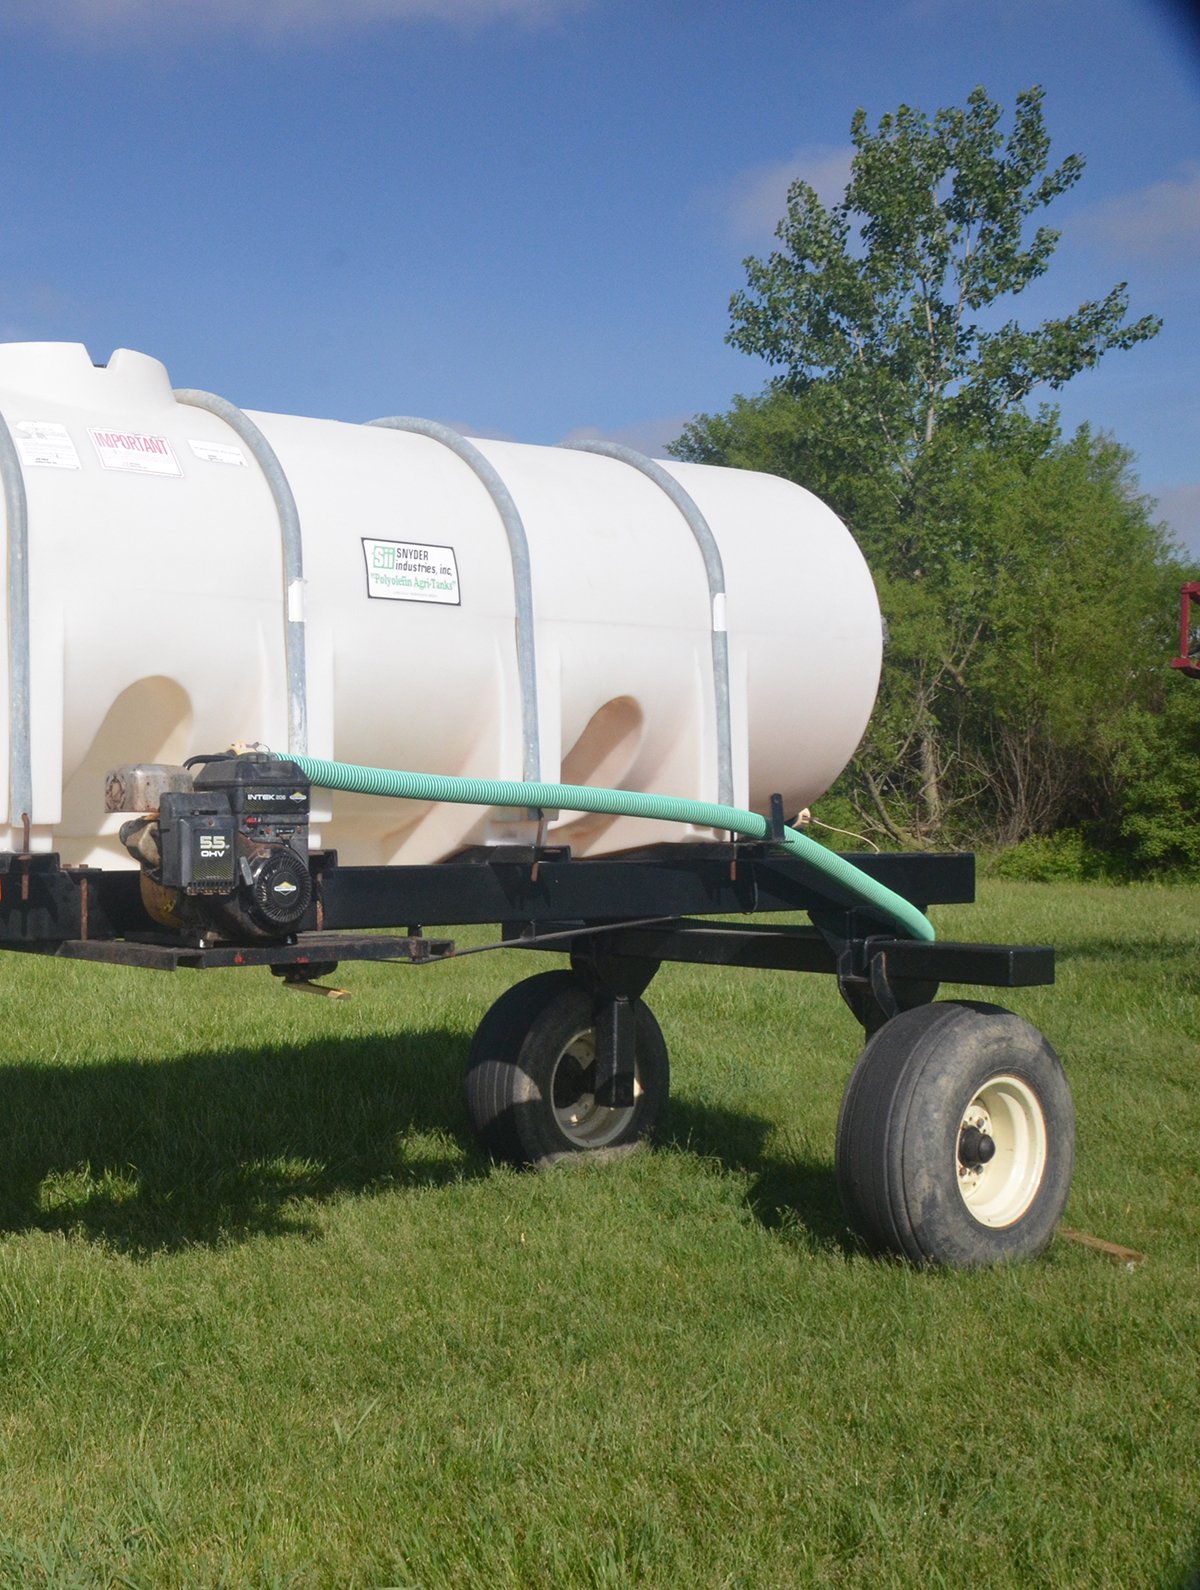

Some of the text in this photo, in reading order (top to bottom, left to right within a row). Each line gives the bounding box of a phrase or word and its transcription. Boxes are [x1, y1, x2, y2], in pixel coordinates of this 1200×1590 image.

[94, 432, 168, 455] IMPORTANT
[396, 547, 429, 561] SNYDER
[395, 560, 436, 575] industries,
